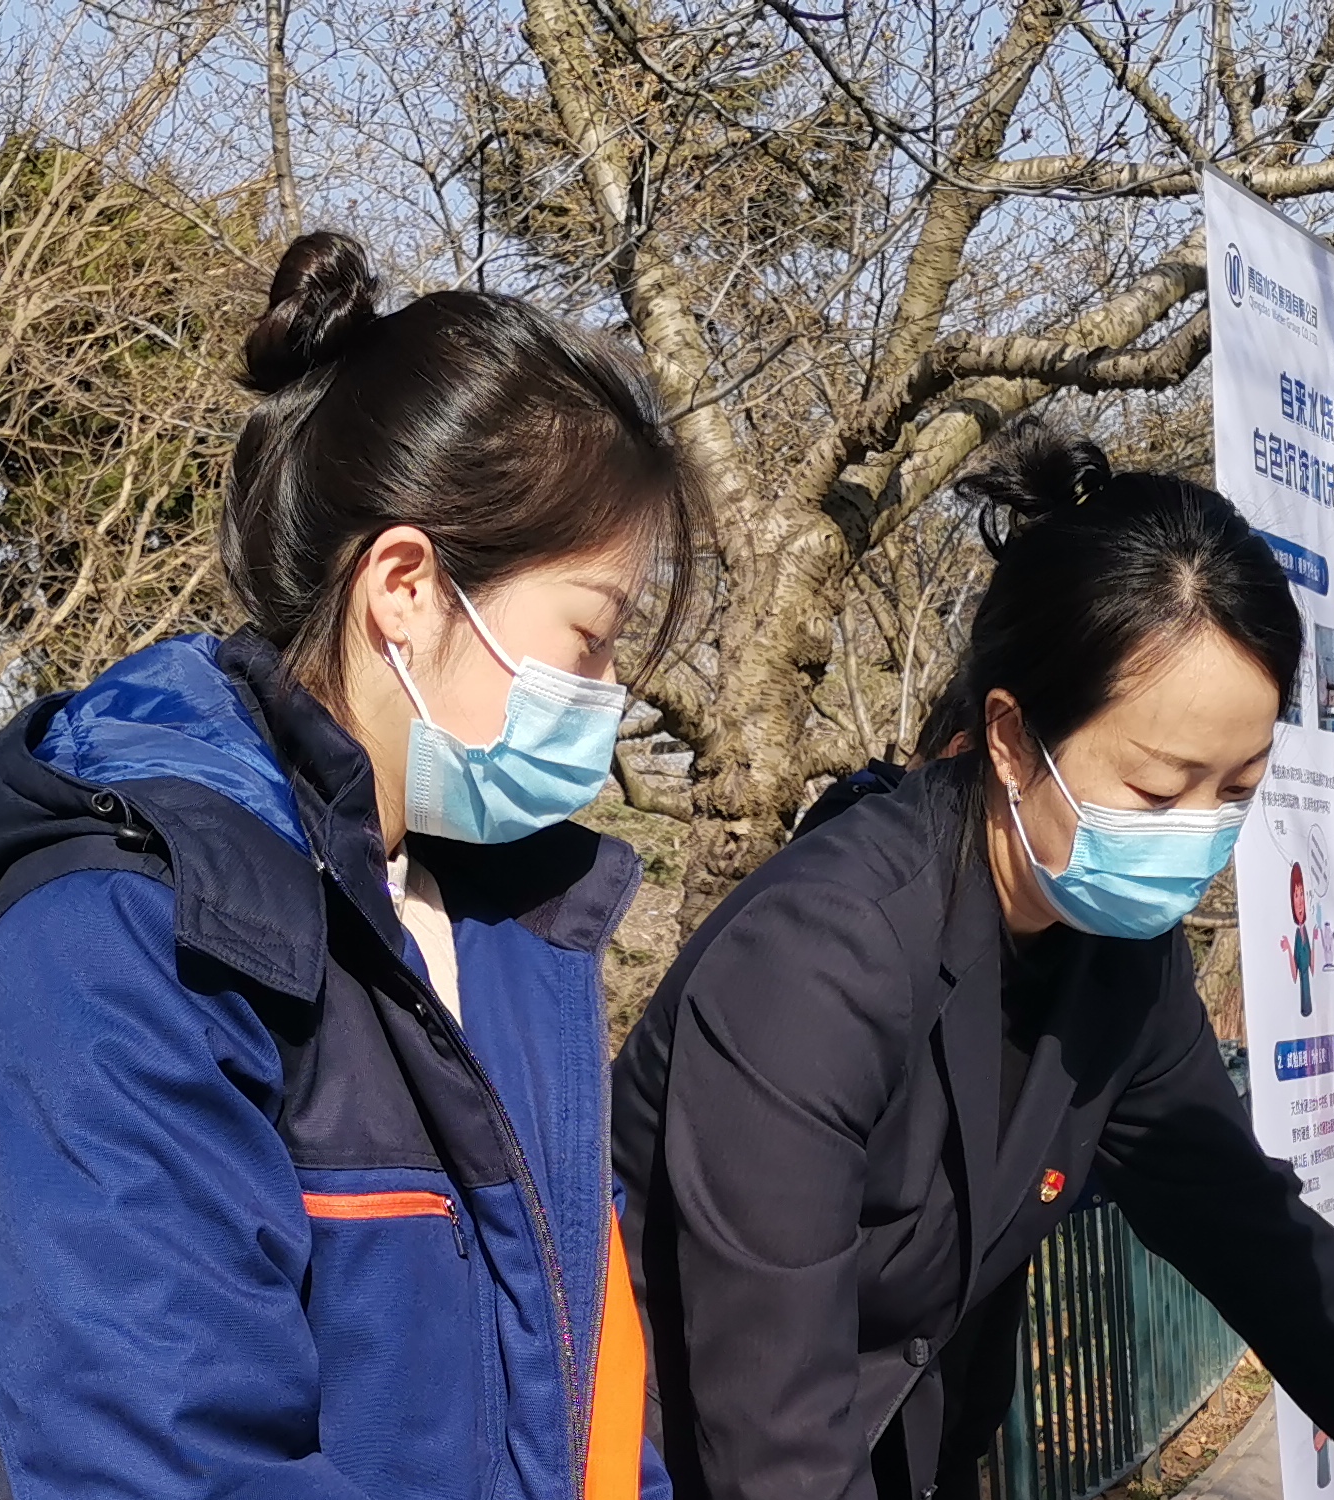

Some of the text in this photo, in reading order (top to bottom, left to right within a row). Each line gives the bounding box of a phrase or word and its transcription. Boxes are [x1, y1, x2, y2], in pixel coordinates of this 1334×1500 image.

[1247, 265, 1318, 330] 青岛水务集团有限公司
